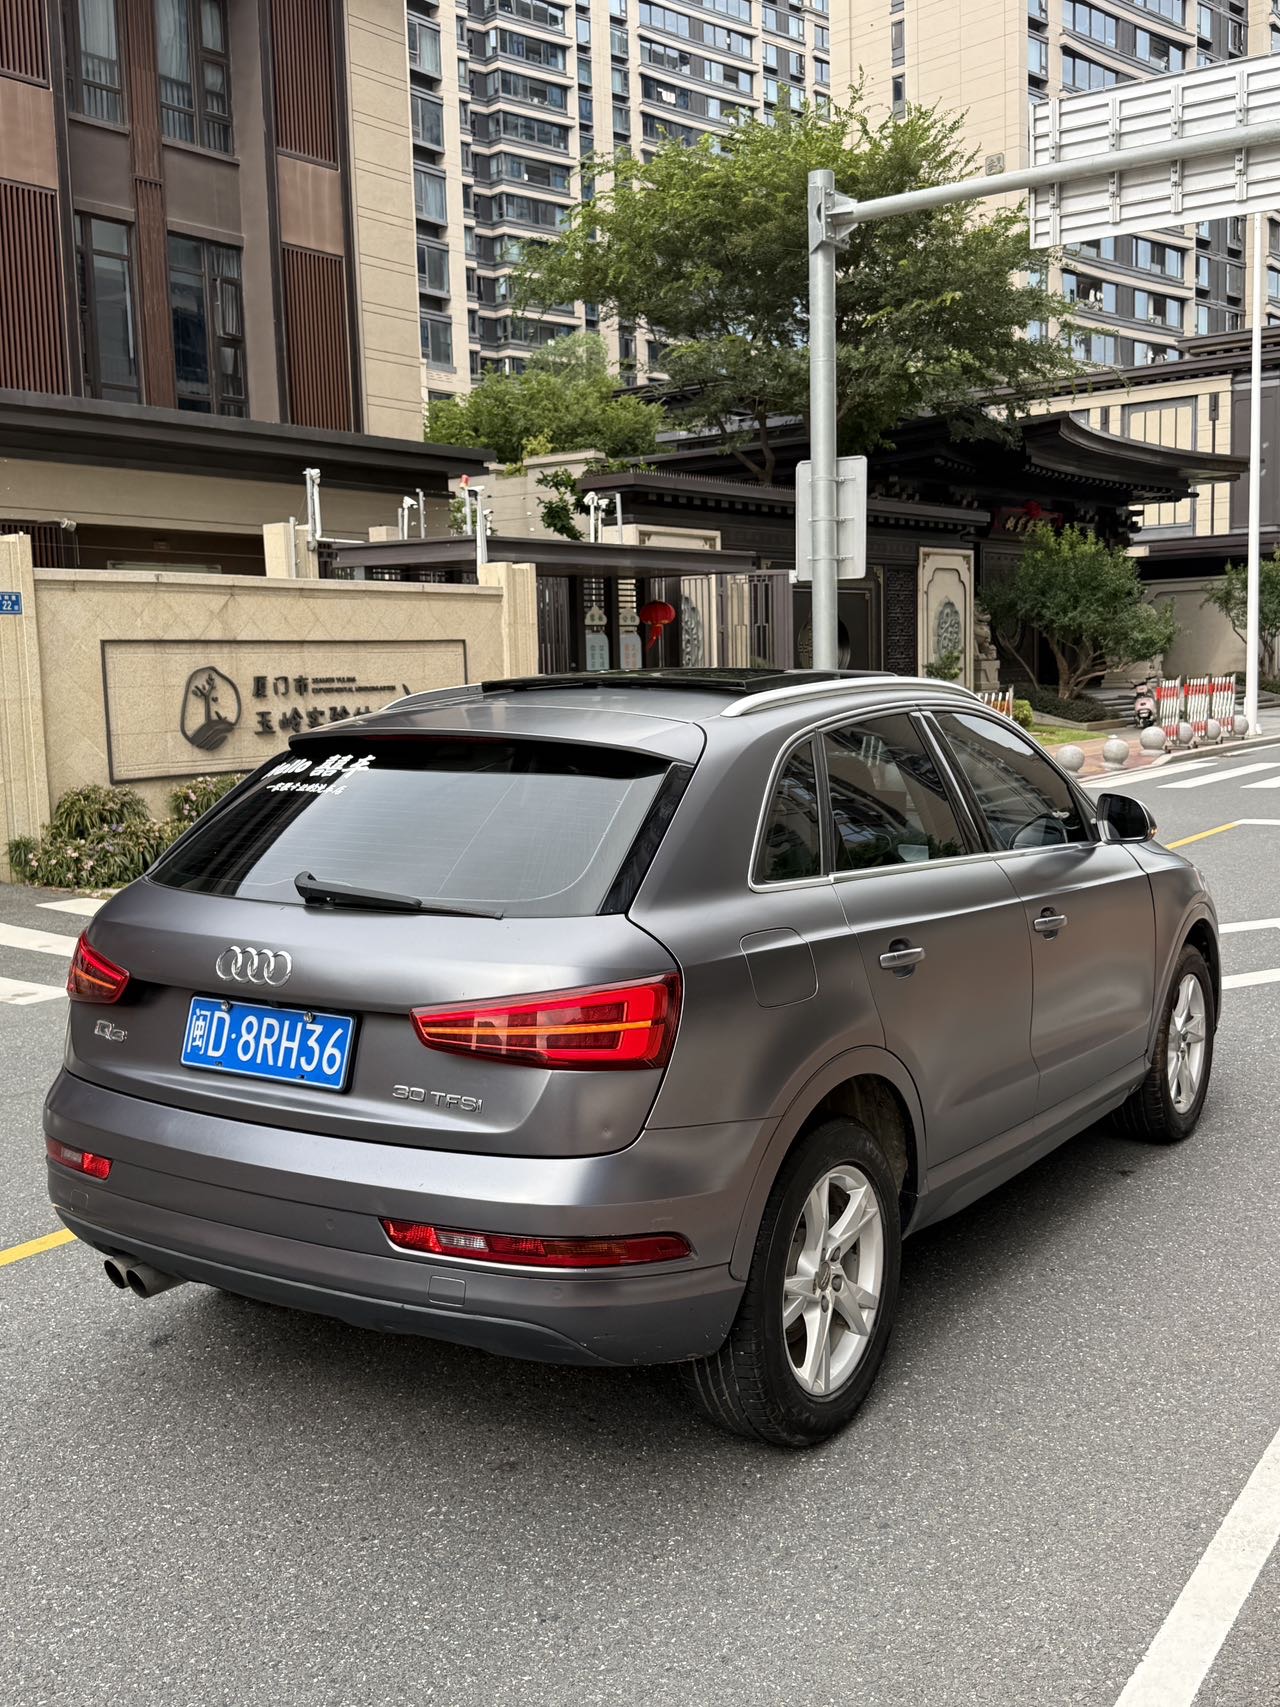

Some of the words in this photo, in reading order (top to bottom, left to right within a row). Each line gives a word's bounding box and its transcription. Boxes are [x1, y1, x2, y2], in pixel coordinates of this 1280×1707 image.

[252, 675, 309, 698] 厦门市
[94, 1020, 126, 1042] Q3
[187, 1008, 344, 1075] 闽D·8RH36
[392, 1085, 427, 1102] 30
[430, 1091, 483, 1113] TFSI
